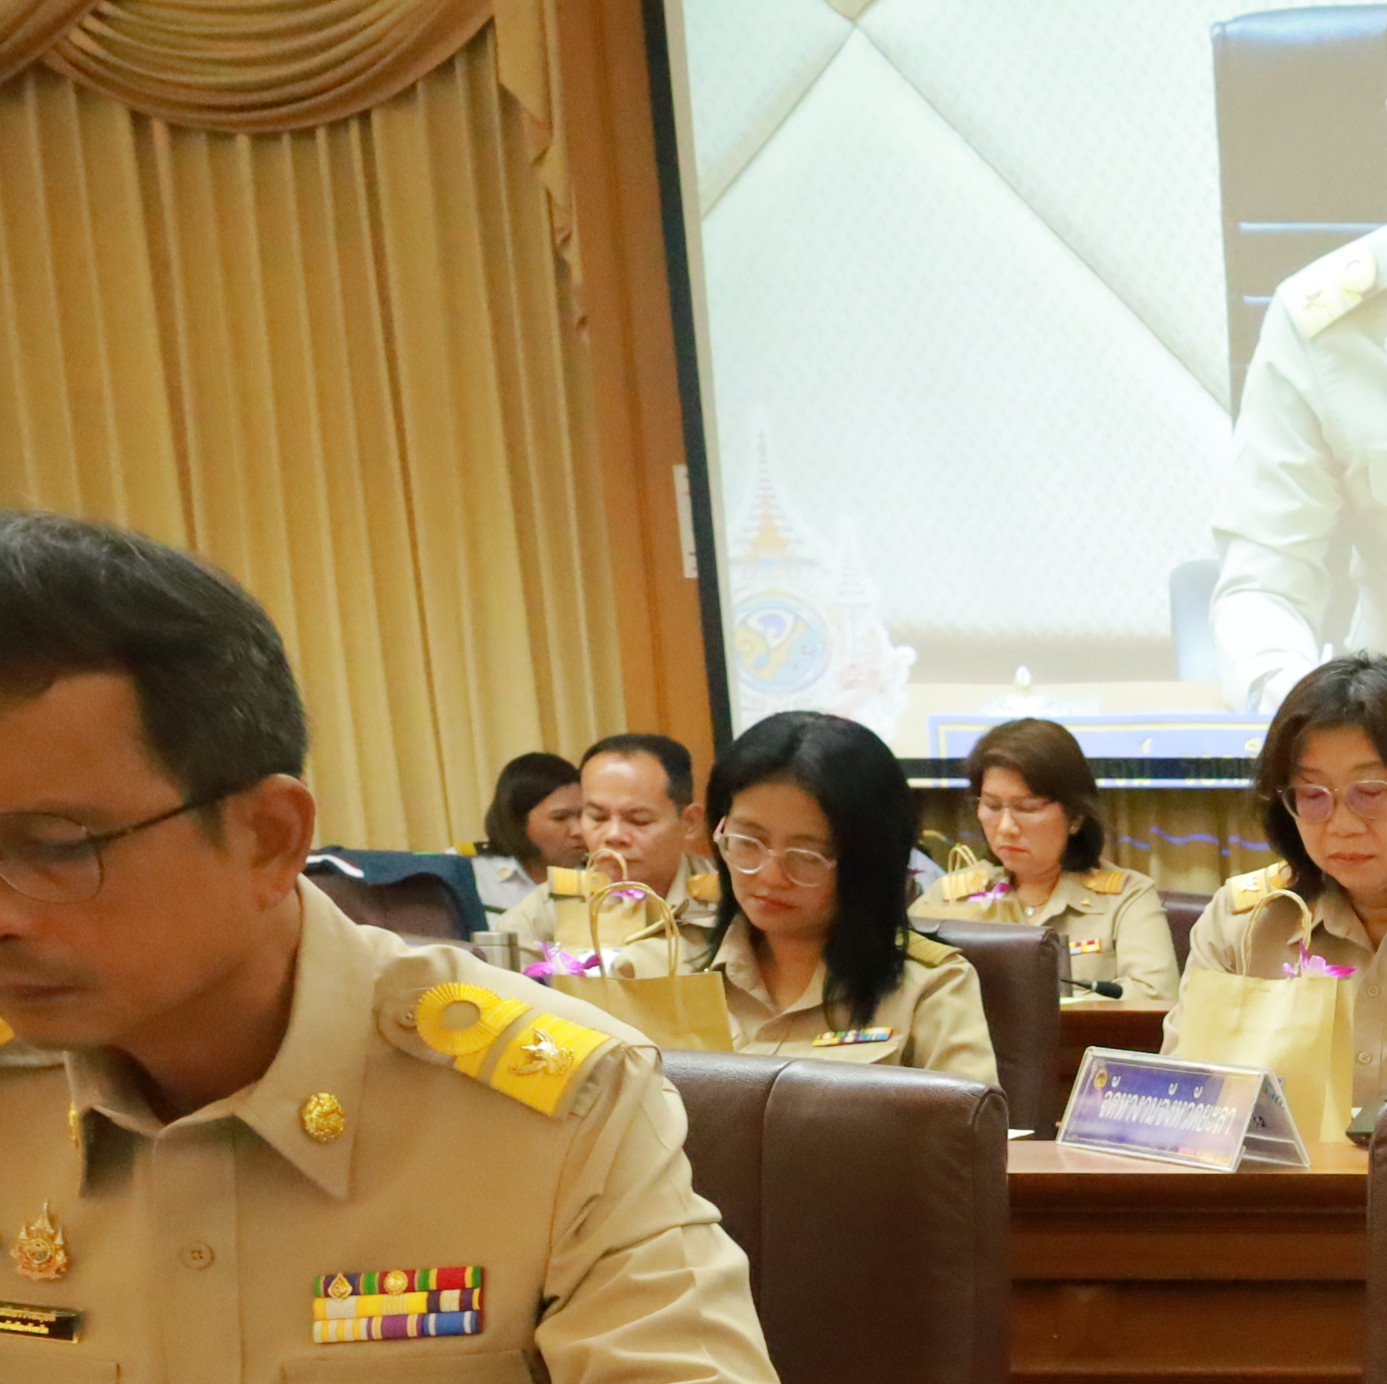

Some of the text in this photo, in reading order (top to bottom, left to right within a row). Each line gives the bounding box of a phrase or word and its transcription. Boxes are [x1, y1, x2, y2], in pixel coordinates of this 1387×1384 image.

[1099, 1075, 1237, 1136] จัดหางานจังหวัดยะลา
